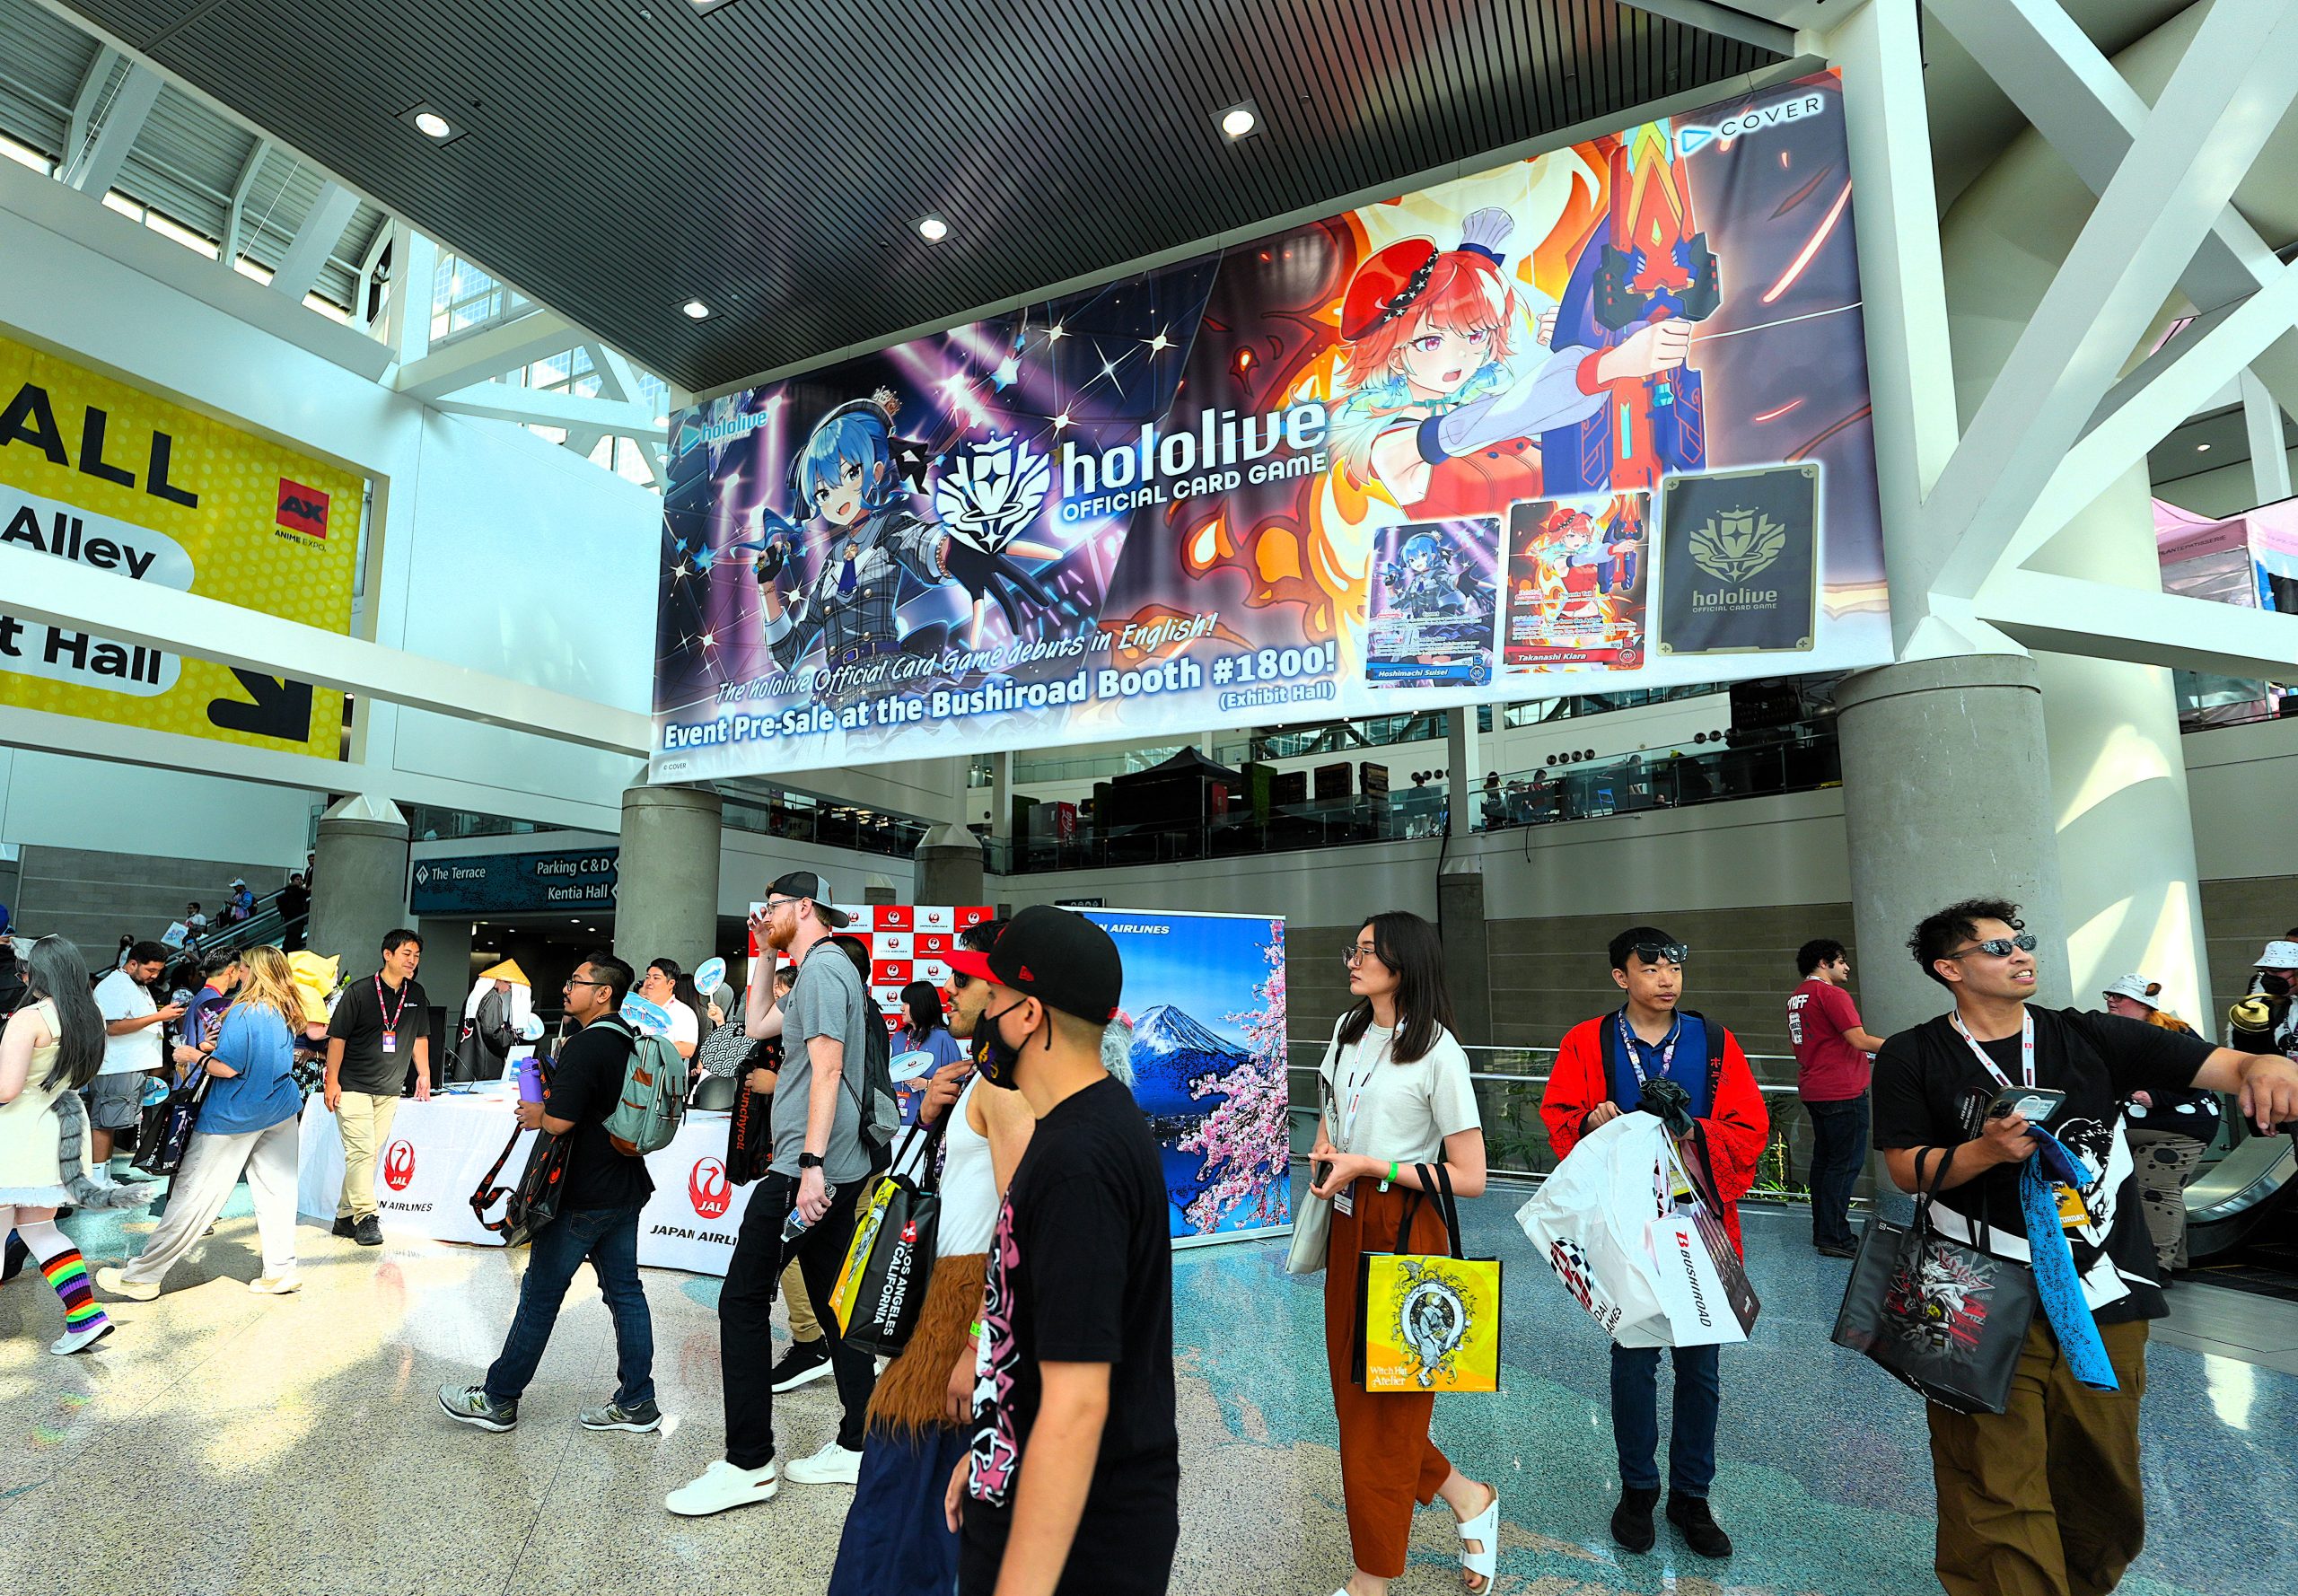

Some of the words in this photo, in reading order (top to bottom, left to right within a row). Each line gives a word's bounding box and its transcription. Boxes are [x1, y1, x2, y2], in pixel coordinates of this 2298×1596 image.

[1721, 97, 1820, 136] COVER
[702, 412, 767, 442] hololive
[1063, 404, 1327, 497] hololive
[1063, 486, 1167, 521] OFFICIAL
[1173, 471, 1241, 498] CARD
[1248, 452, 1328, 484] GAME
[280, 495, 324, 523] AX
[0, 505, 156, 579] Alley
[275, 530, 302, 544] ANIME
[1693, 588, 1778, 608] hololive
[1693, 604, 1728, 613] OFFICIAL
[1753, 602, 1777, 610] GAME
[44, 624, 162, 685] Hall
[716, 681, 746, 703] The
[749, 673, 810, 699] hololive
[813, 661, 889, 694] Official
[892, 653, 936, 680] Card
[942, 647, 1000, 674] Game
[1008, 636, 1083, 663] debuts
[1090, 630, 1112, 652] in
[1118, 611, 1220, 653] English!
[1379, 670, 1423, 678] Hoshimachi
[663, 719, 727, 749] Event
[733, 706, 834, 741] Pre-Sale
[841, 704, 869, 729] at
[875, 695, 923, 725] the
[932, 670, 1088, 719] Bushiroad
[1097, 658, 1202, 698] Booth
[1213, 641, 1337, 686] #1800!
[1219, 686, 1288, 712] (Exhibit
[1293, 681, 1337, 701] Hall)
[668, 762, 687, 770] COVER
[432, 867, 449, 881] The
[452, 865, 486, 880] Terrace
[537, 860, 577, 877] Parking
[580, 860, 589, 873] C
[590, 858, 600, 873] &
[601, 859, 610, 873] D
[548, 885, 583, 900] Kentia
[585, 883, 608, 899] Hall
[1110, 924, 1171, 934] AIRLINES
[1787, 994, 1810, 1011] TAFF
[390, 1177, 407, 1186] JAL
[389, 1202, 433, 1212] AIRLINES
[698, 1201, 724, 1213] JAL
[650, 1224, 696, 1240] JAPAN
[1683, 1250, 1712, 1328] BUSHIROAD
[883, 1276, 908, 1336] ANGELES
[1606, 1307, 1622, 1337] AMES
[1370, 1367, 1394, 1375] Witch
[1372, 1377, 1406, 1388] Atelier
